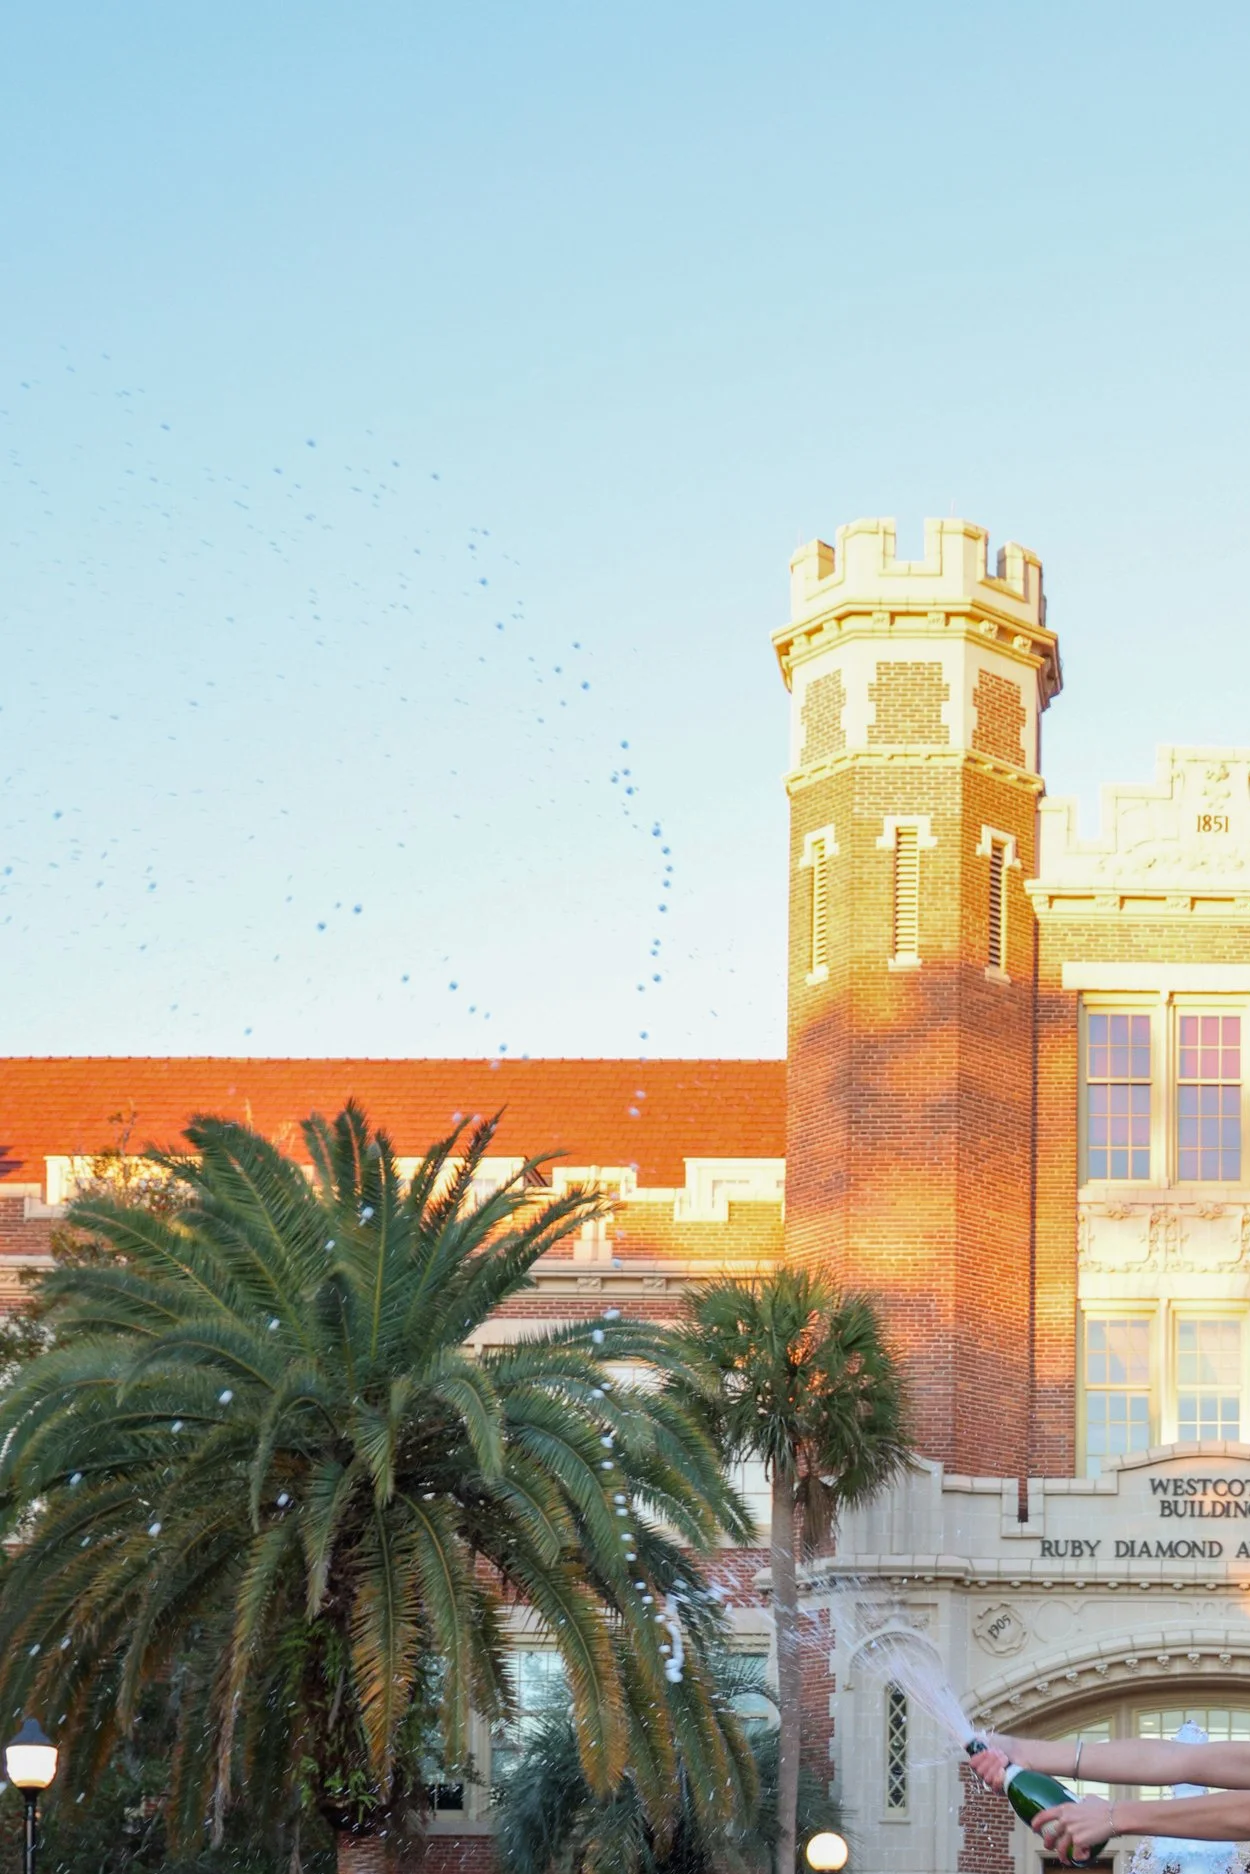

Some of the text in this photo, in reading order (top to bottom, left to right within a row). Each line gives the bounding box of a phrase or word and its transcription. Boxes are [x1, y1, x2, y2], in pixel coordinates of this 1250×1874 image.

[1196, 814, 1229, 833] 1851
[1040, 1539, 1101, 1558] RUBY
[1115, 1540, 1223, 1558] DIAMOND
[987, 1614, 1012, 1640] 1905
